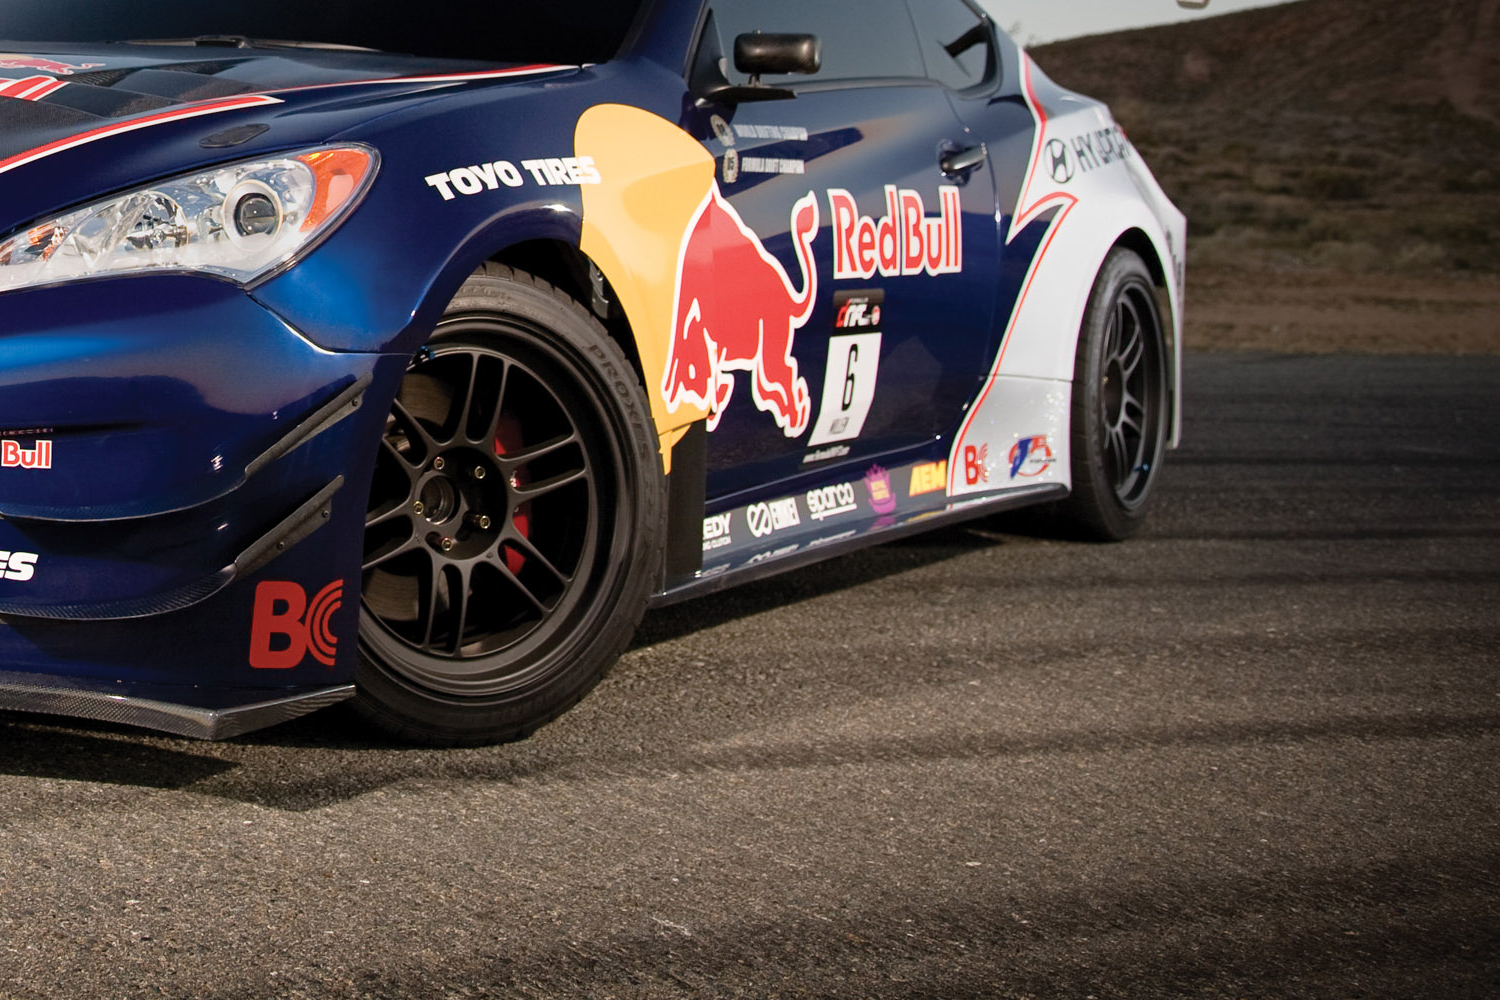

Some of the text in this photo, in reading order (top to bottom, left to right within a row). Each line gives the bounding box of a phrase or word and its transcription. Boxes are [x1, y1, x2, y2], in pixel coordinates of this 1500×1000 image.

[425, 155, 601, 201] TOYO TIRES
[842, 343, 859, 412] 6
[587, 343, 649, 461] PROXES
[806, 482, 855, 517] sparco
[909, 460, 947, 497] AEM
